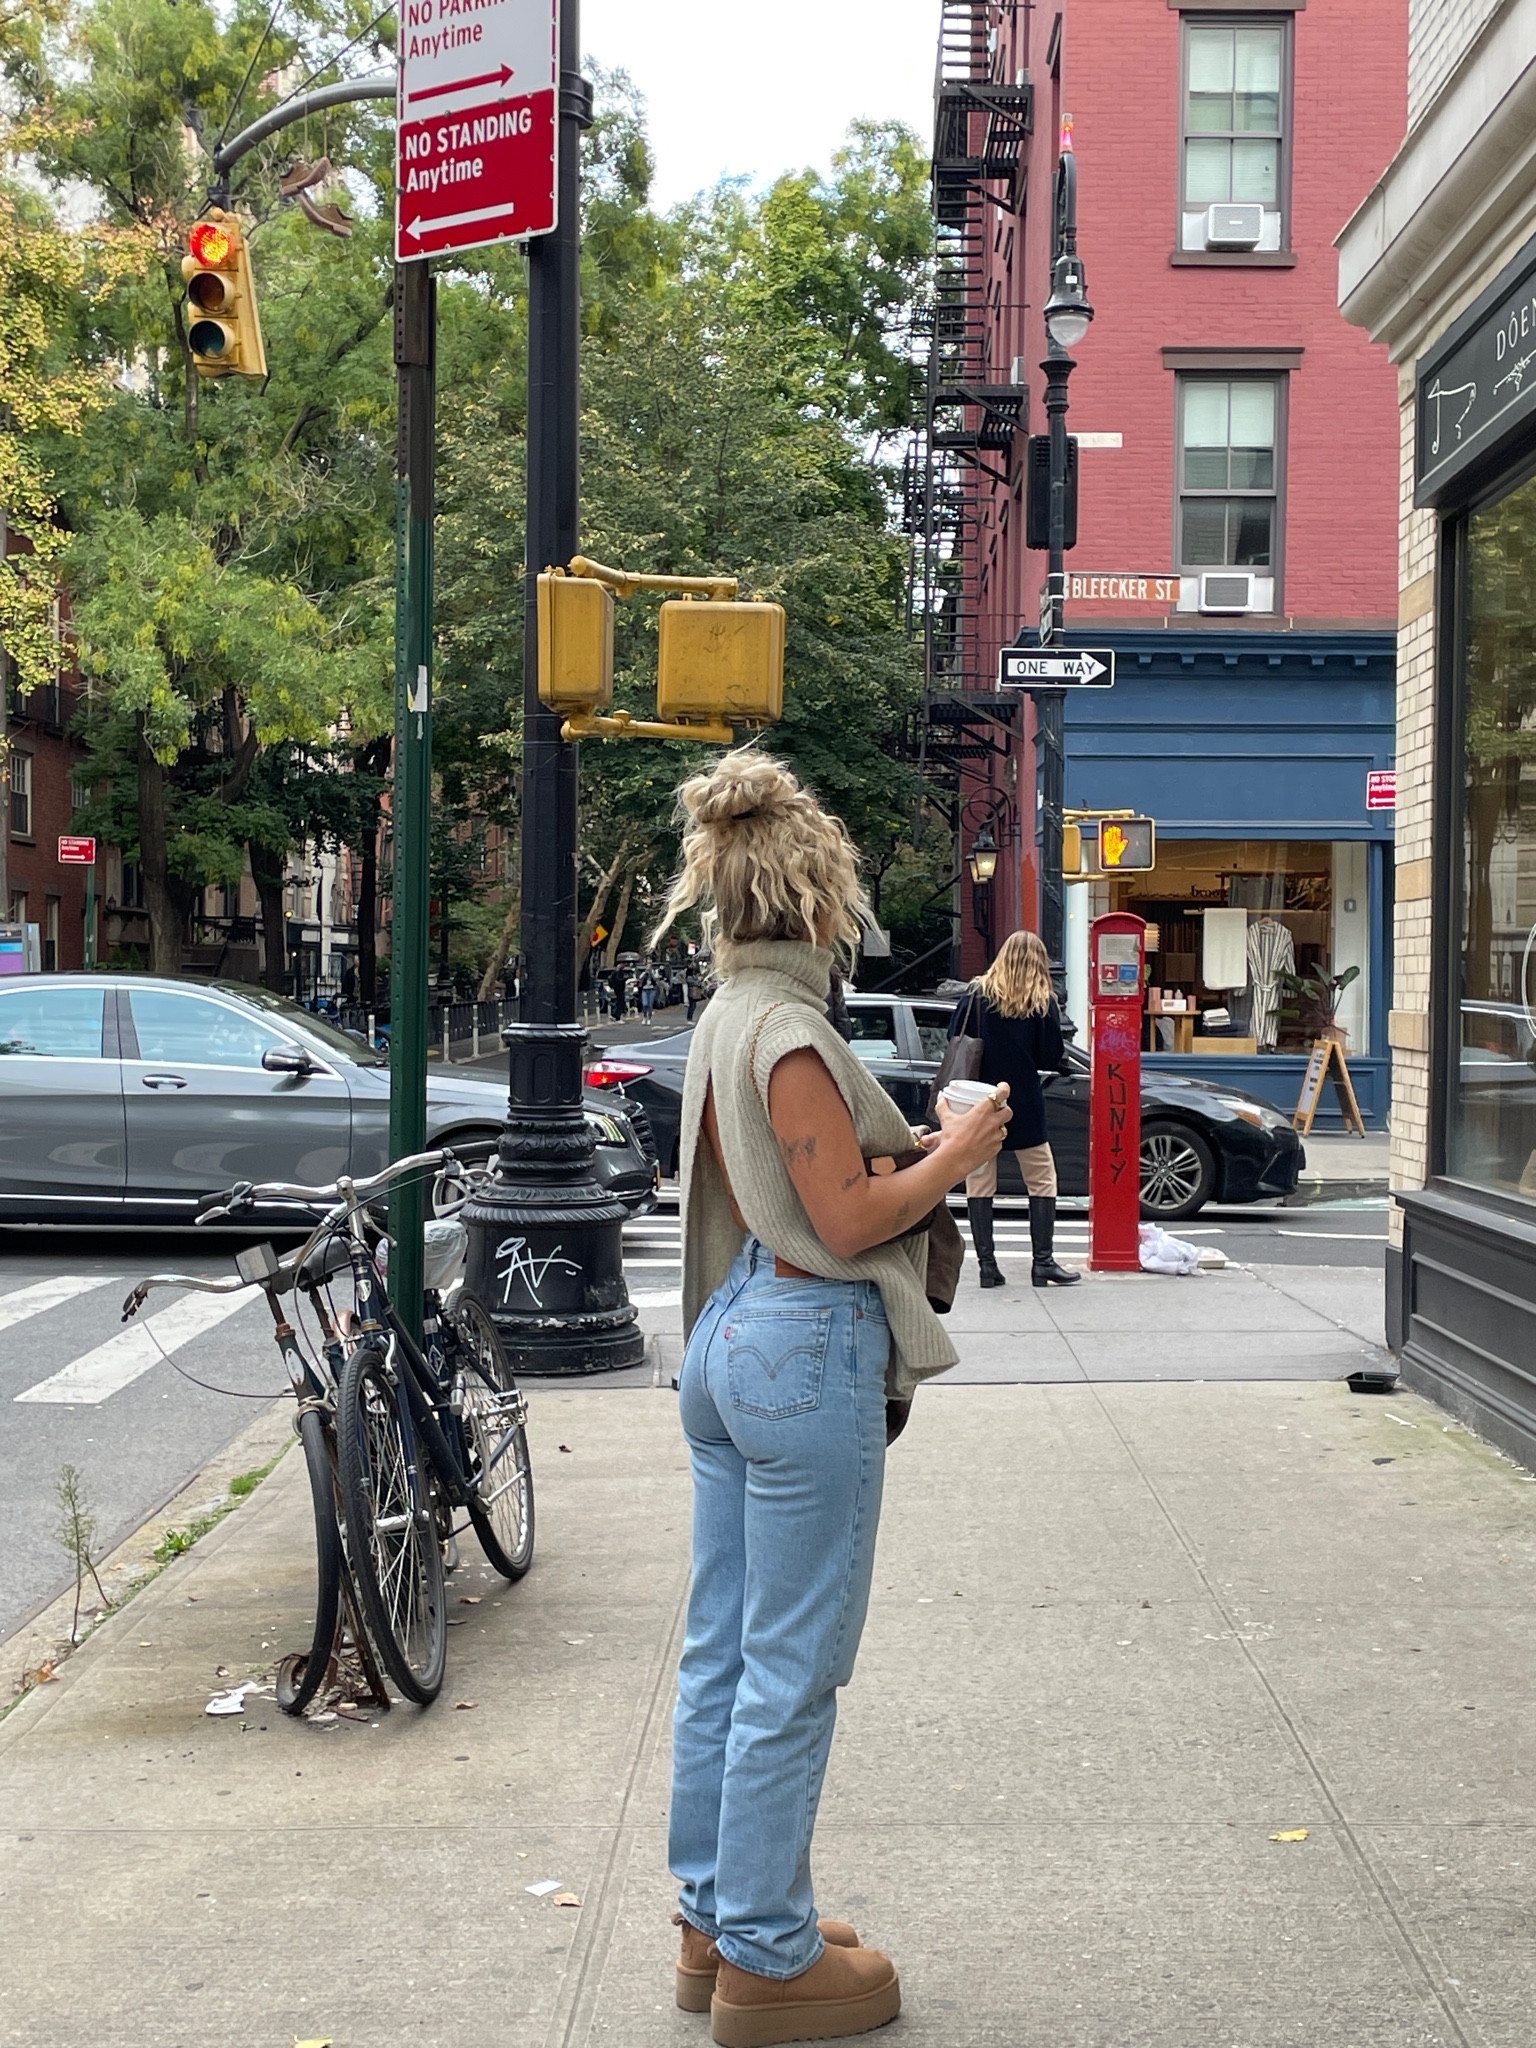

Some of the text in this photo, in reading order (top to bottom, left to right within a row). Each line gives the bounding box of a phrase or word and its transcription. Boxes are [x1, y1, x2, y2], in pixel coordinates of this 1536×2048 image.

[408, 0, 432, 28] NO
[408, 24, 483, 59] Anytime
[405, 107, 532, 161] NO STANDING
[406, 157, 484, 193] Anytime
[1072, 577, 1173, 600] BLEECKER ST
[1016, 660, 1096, 675] ONE WAY
